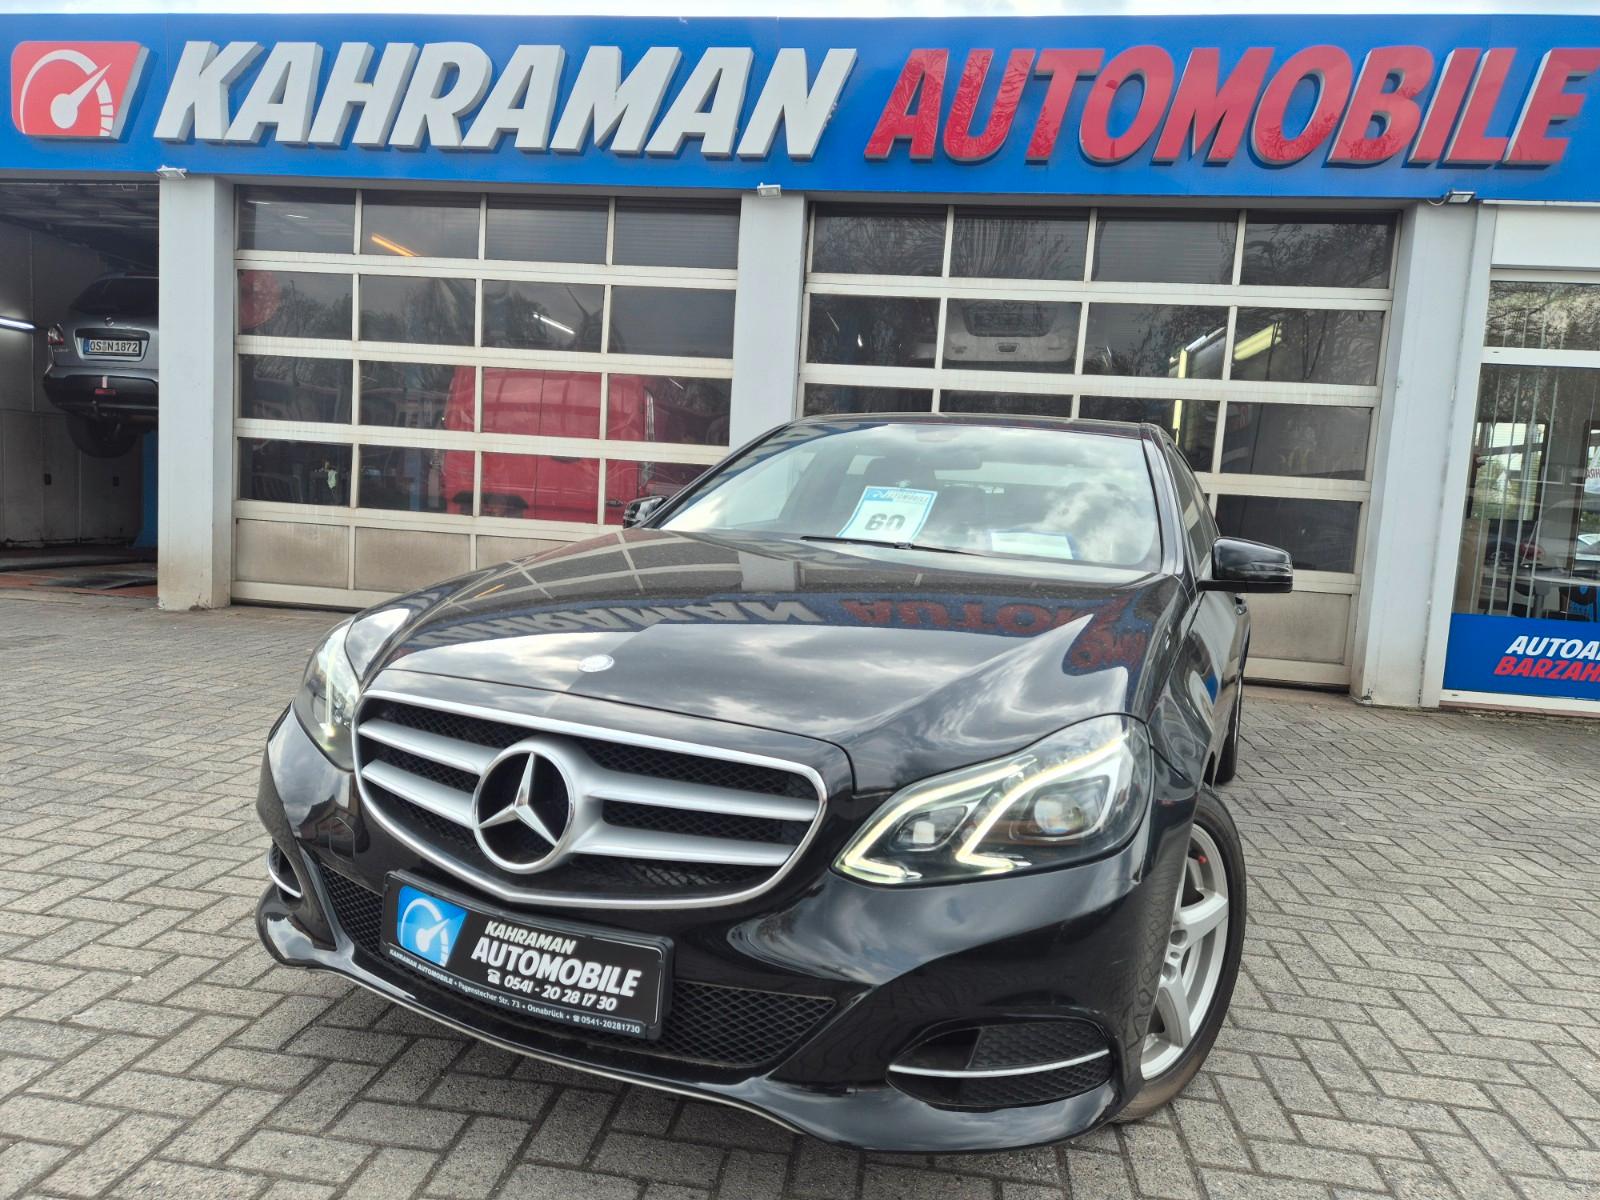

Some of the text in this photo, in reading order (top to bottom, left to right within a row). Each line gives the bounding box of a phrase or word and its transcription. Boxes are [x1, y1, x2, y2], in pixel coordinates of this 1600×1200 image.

[153, 40, 1600, 167] KAHRAMAN AUTOMOBILE
[1505, 636, 1600, 660] AUTOA
[1494, 656, 1600, 682] BARZAH
[484, 920, 577, 955] KAHRAMAN
[471, 936, 642, 997] AUTOMOBILE
[418, 964, 453, 985] AUTOMOBILE
[459, 982, 497, 1001] Pagenstecher
[511, 999, 520, 1008] 73
[527, 1004, 564, 1019] Osnabrück
[581, 1015, 641, 1034] 0541-20281730
[504, 975, 534, 993] 0541
[541, 985, 561, 1000] 20
[562, 989, 580, 1004] 28
[582, 993, 597, 1007] 17
[596, 996, 617, 1011] 30
